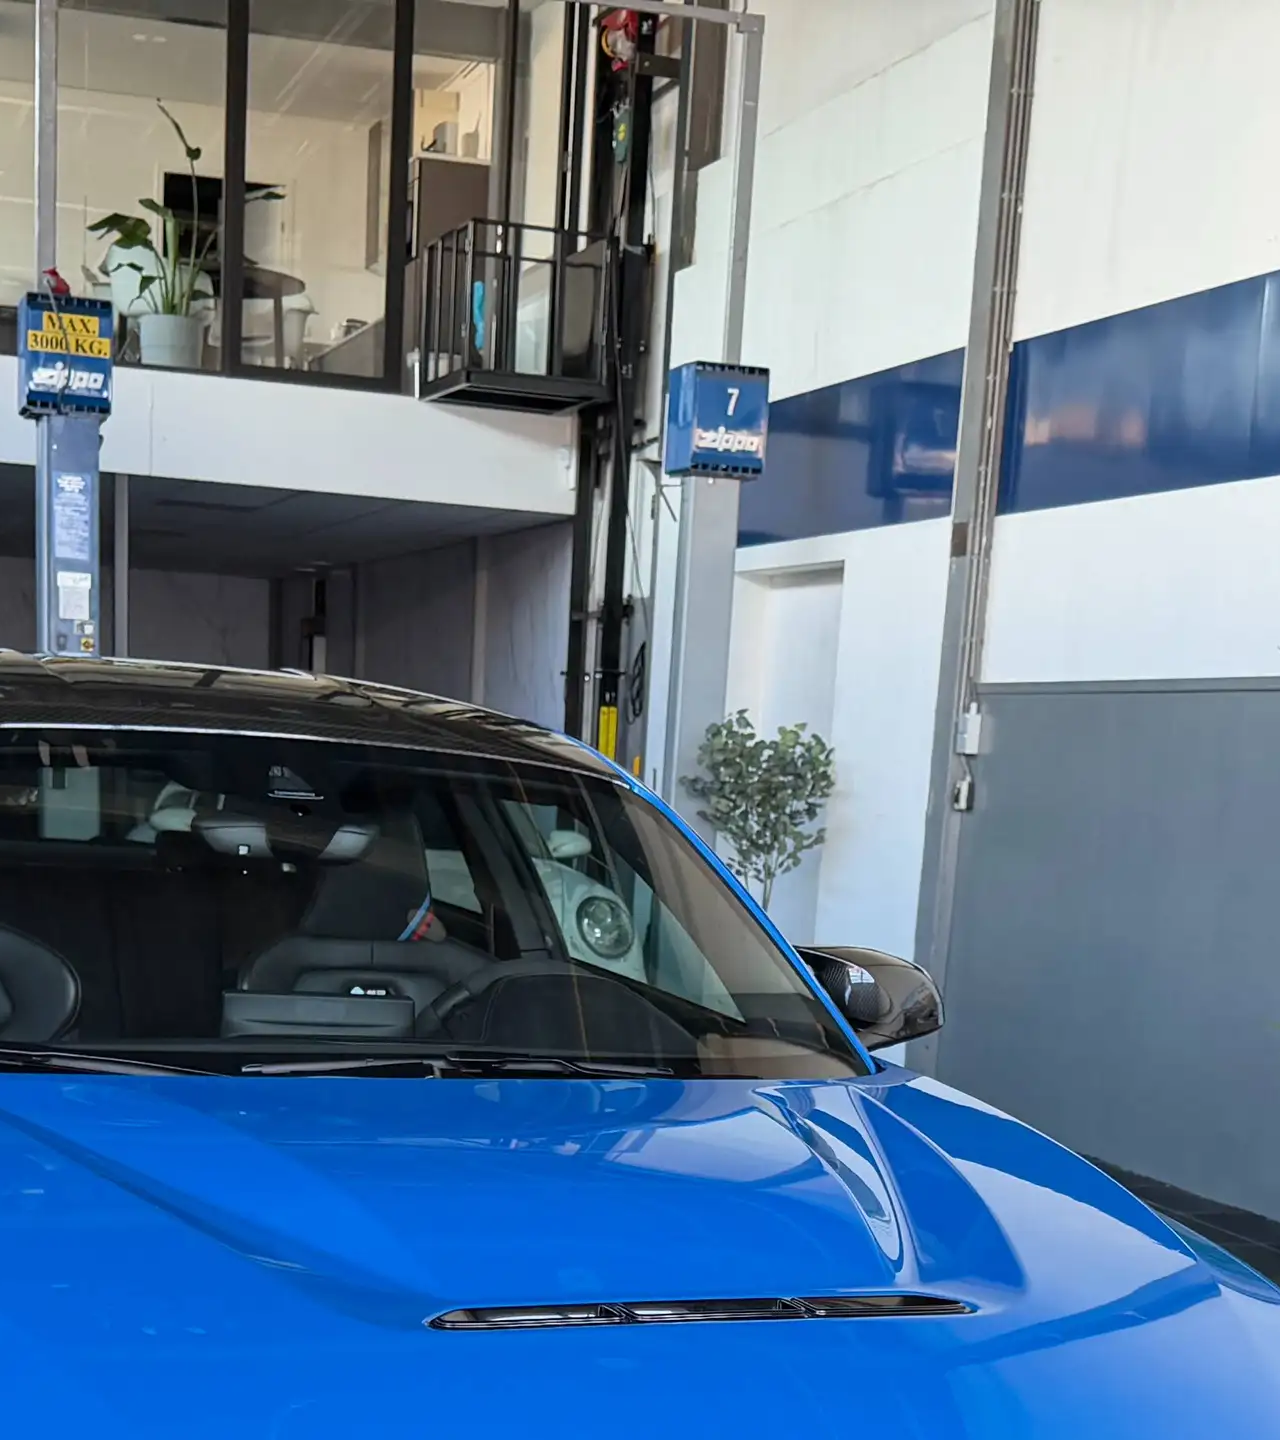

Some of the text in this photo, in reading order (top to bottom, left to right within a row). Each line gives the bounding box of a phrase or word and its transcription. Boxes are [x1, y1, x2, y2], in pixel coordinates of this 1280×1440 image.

[47, 314, 96, 334] MAX.
[75, 338, 108, 356] KG.
[727, 388, 740, 416] 7
